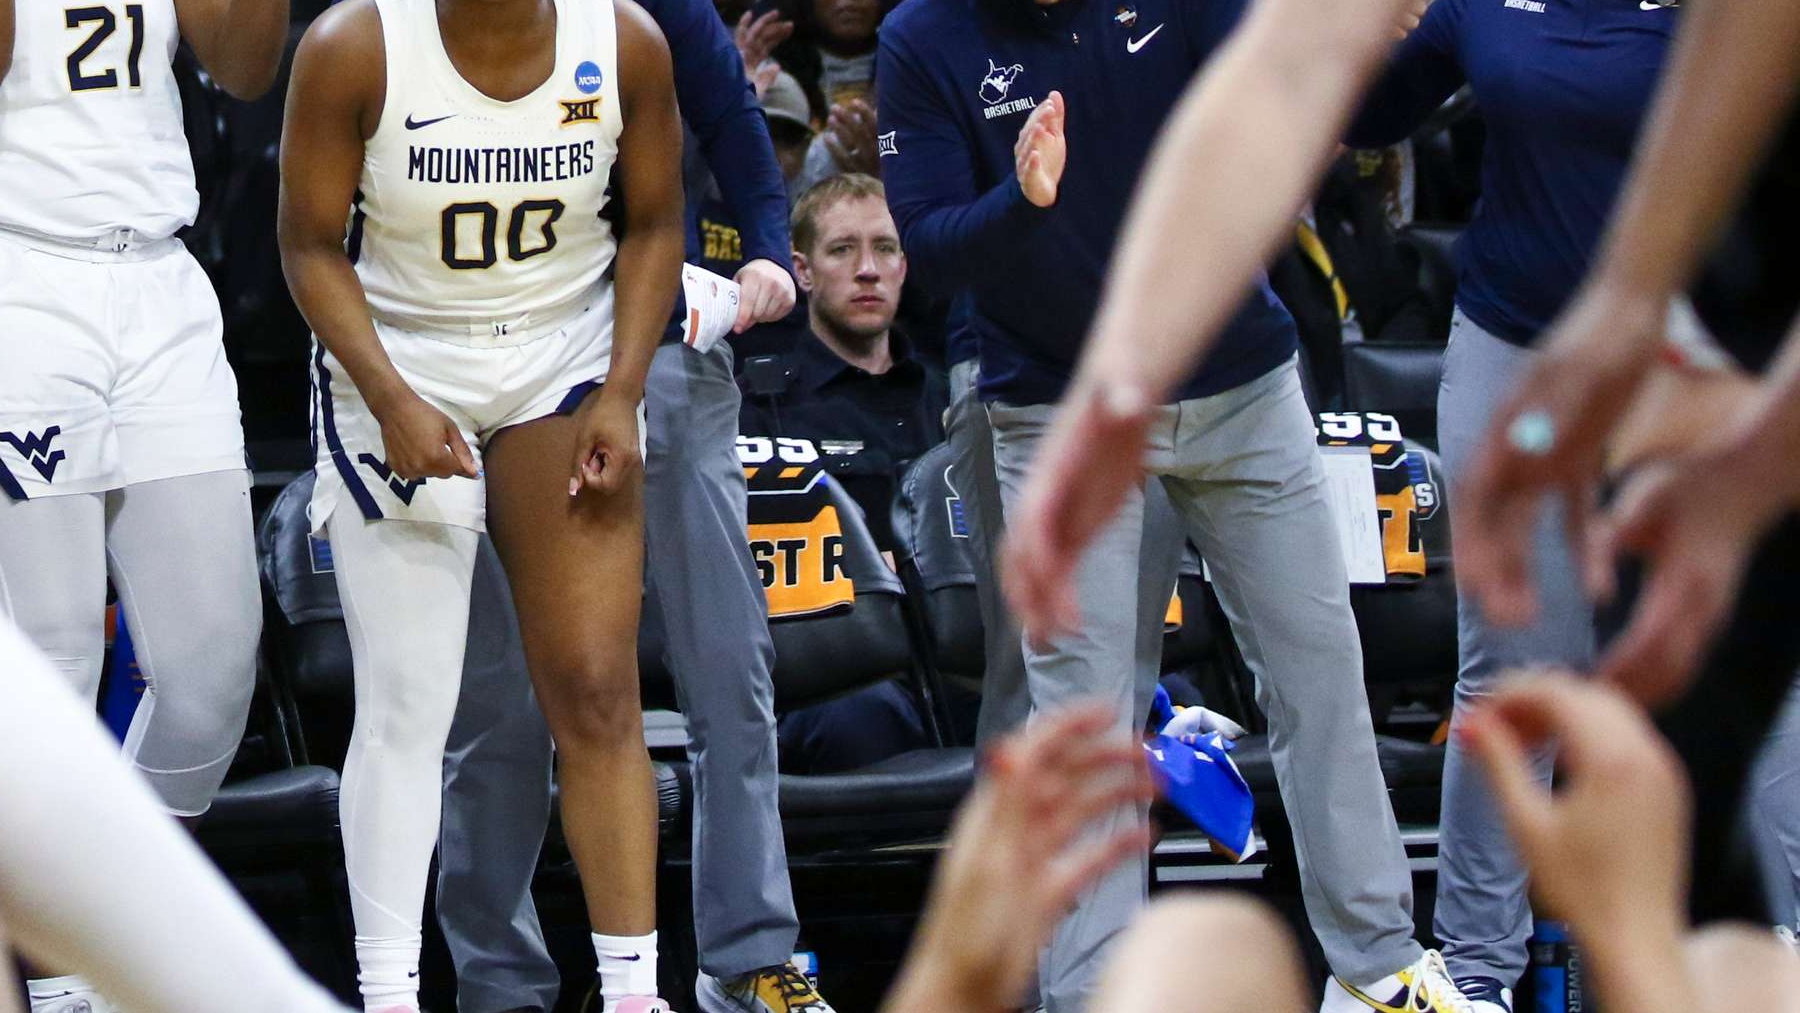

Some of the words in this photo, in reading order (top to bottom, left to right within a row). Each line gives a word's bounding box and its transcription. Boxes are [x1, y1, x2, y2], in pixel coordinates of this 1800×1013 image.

[65, 2, 145, 92] 21
[983, 96, 1037, 120] BASKETBALL
[408, 140, 594, 184] MOUNTAINEERS
[440, 197, 567, 270] 00
